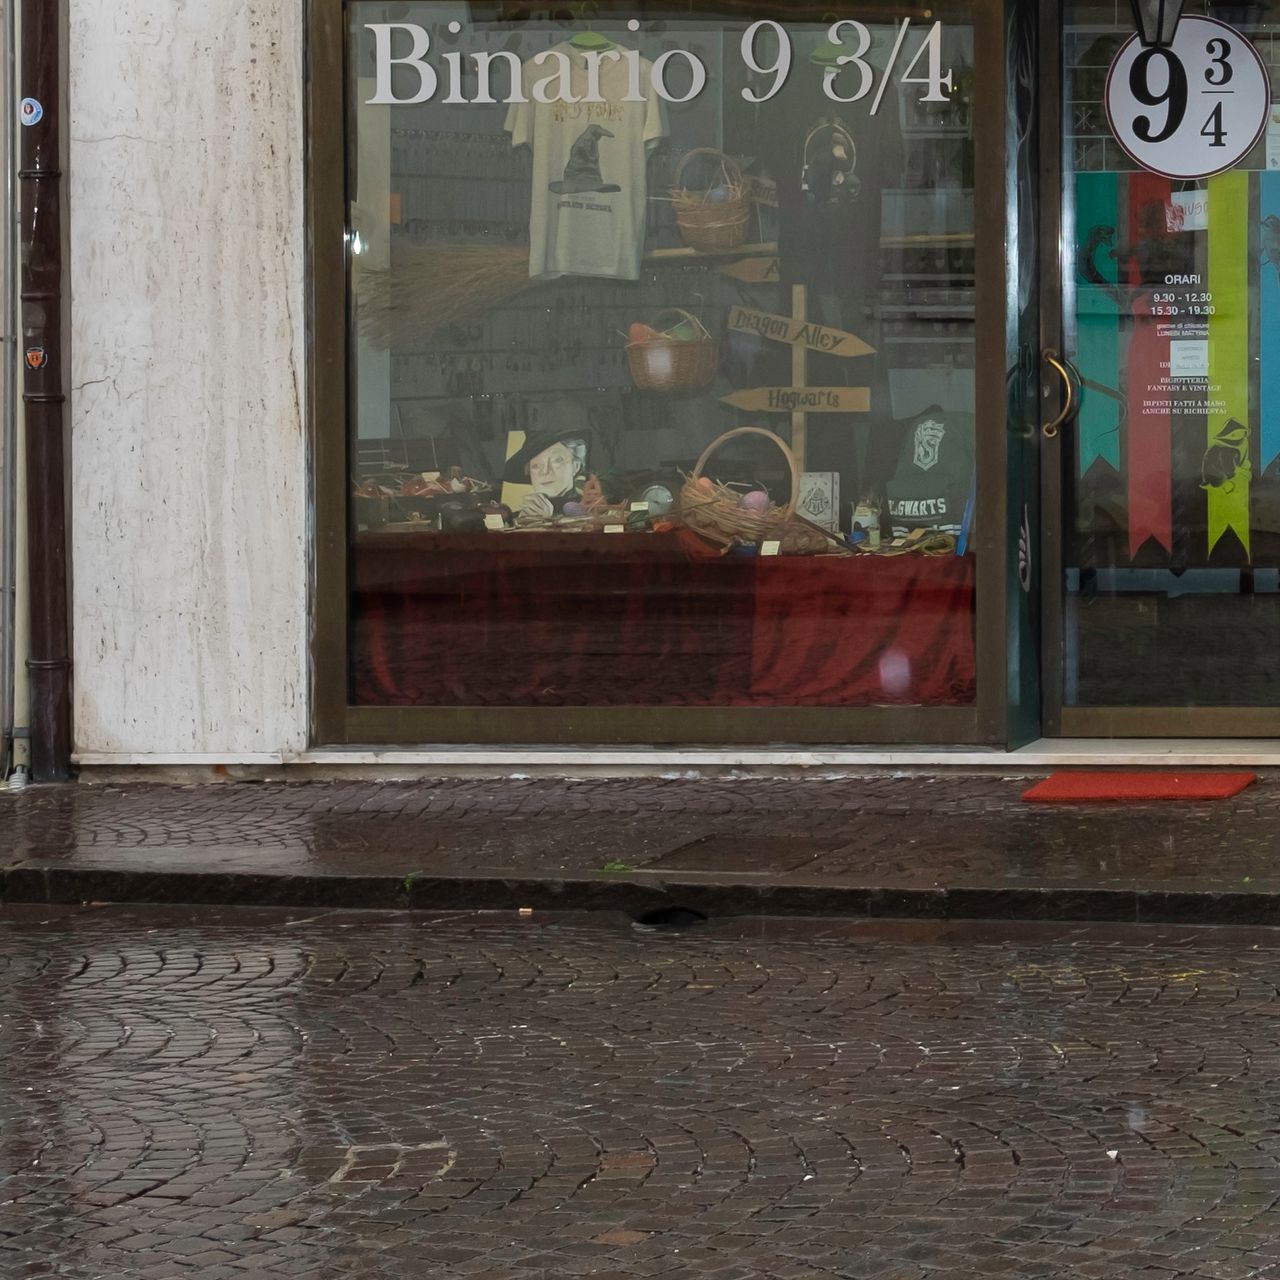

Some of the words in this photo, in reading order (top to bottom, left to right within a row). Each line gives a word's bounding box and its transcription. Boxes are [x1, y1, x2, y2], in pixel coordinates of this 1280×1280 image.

[364, 19, 707, 105] Binario
[740, 20, 792, 104] 9
[822, 16, 954, 116] 3/4
[1129, 47, 1188, 144] 9
[1164, 274, 1201, 285] ORARI
[1153, 293, 1175, 302] 9.30
[1184, 293, 1212, 302] 12.30
[1151, 306, 1178, 315] 15.30
[1188, 306, 1216, 315] 19.30
[735, 310, 790, 339] Diagon
[792, 322, 847, 351] Alley
[767, 389, 840, 411] Hogwarts
[888, 498, 947, 517] GWARTS
